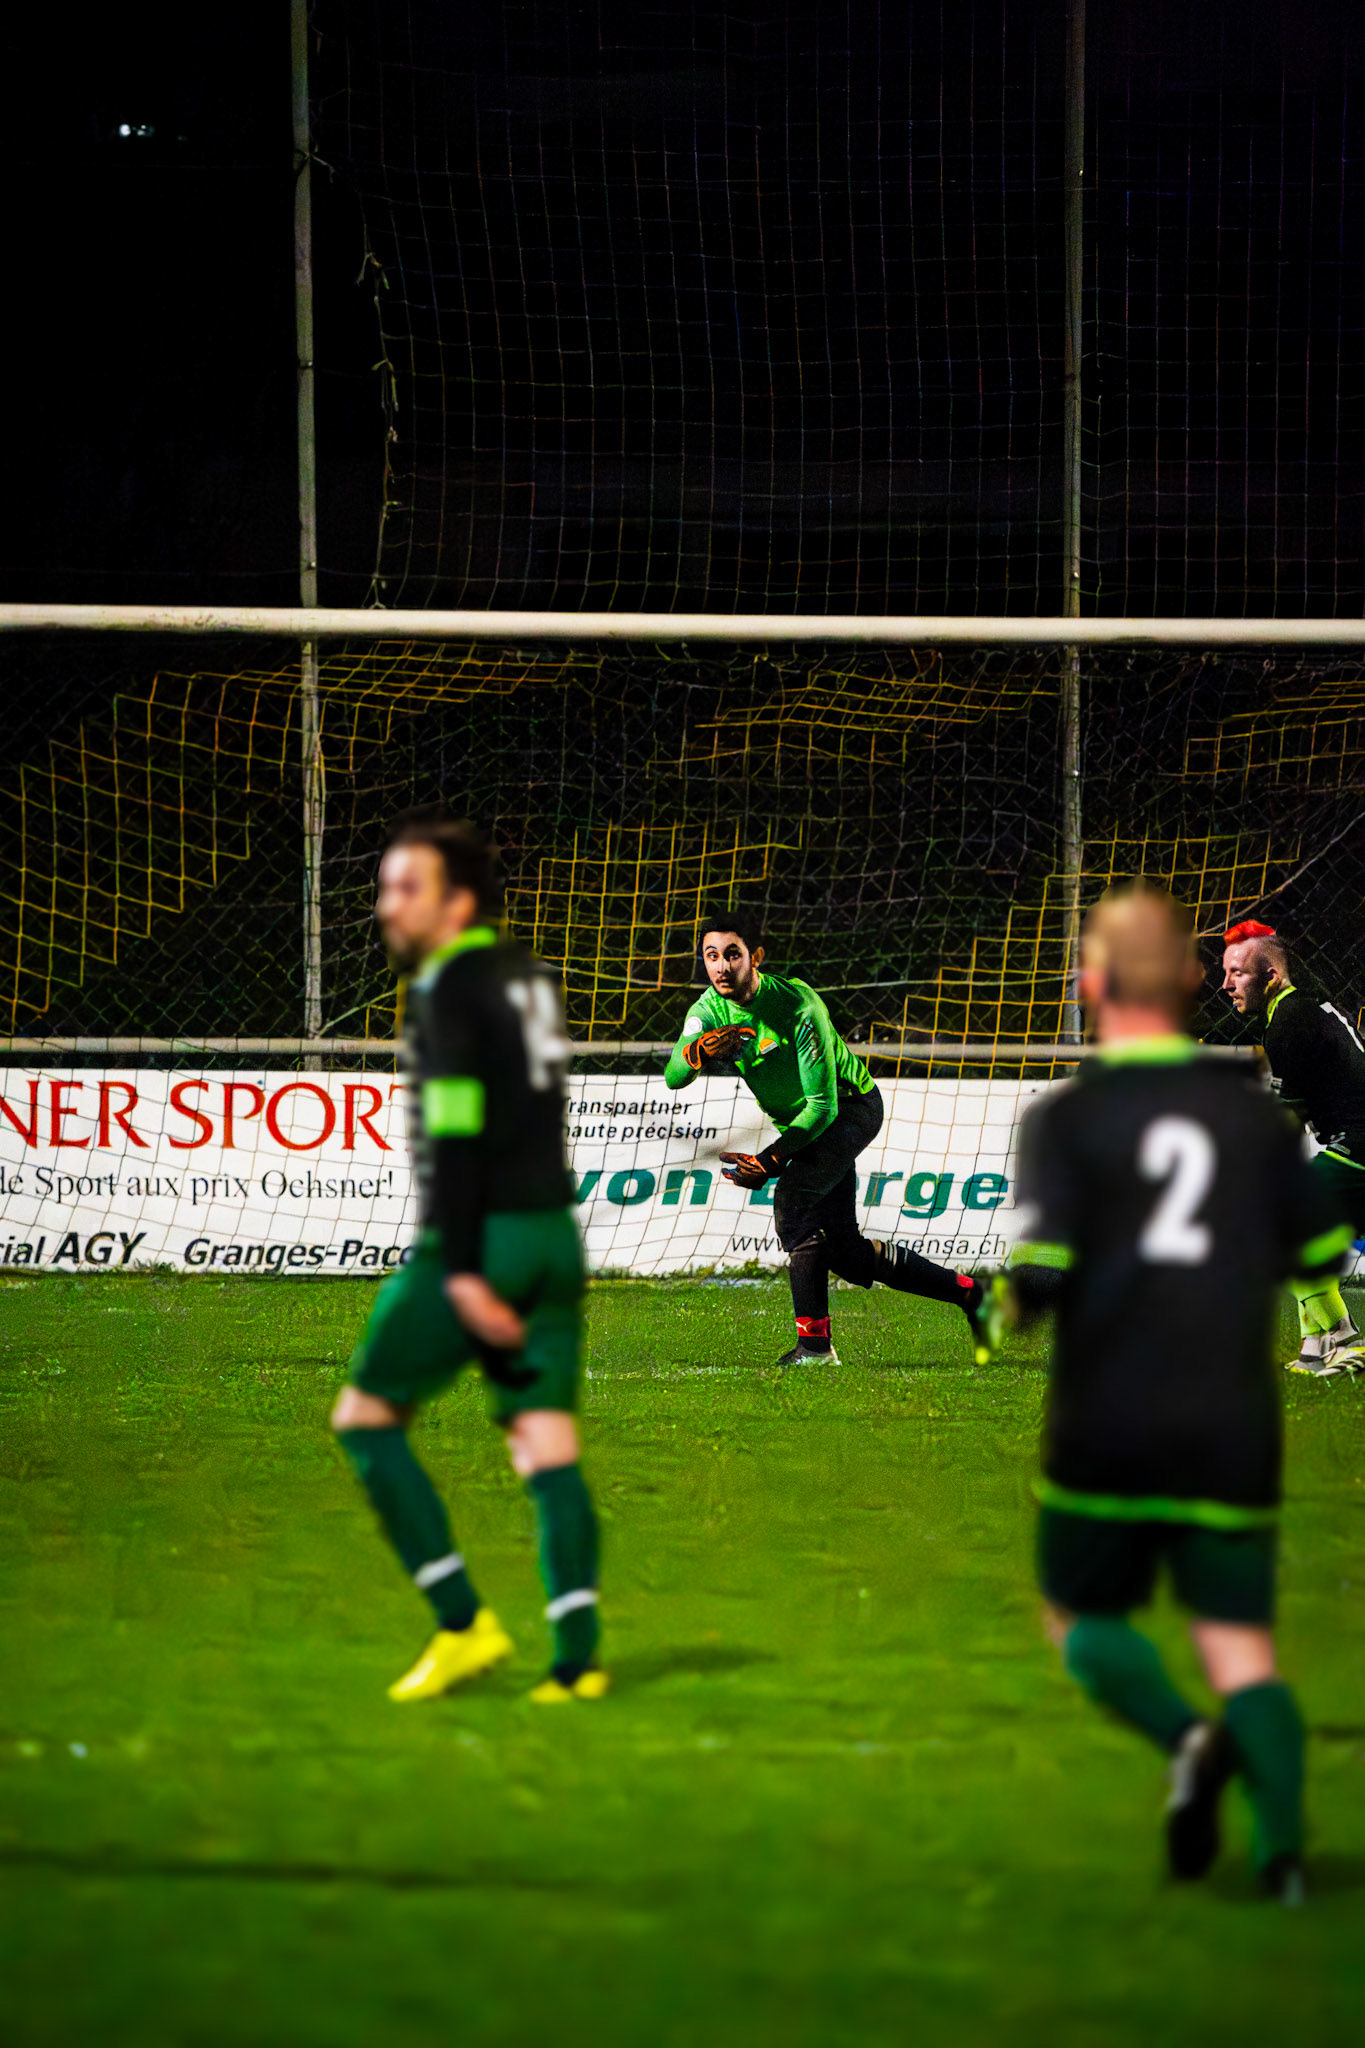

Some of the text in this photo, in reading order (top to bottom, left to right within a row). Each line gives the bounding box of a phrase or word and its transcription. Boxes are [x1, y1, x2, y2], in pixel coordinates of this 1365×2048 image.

[567, 1097, 692, 1117] ranspartner
[566, 1122, 717, 1141] aute précision
[35, 1166, 119, 1204] Sport
[127, 1176, 178, 1197] aux
[192, 1171, 249, 1204] prix
[261, 1170, 393, 1199] Ochsner!
[1138, 1115, 1216, 1268] 2
[0, 1231, 147, 1265] ial AGY
